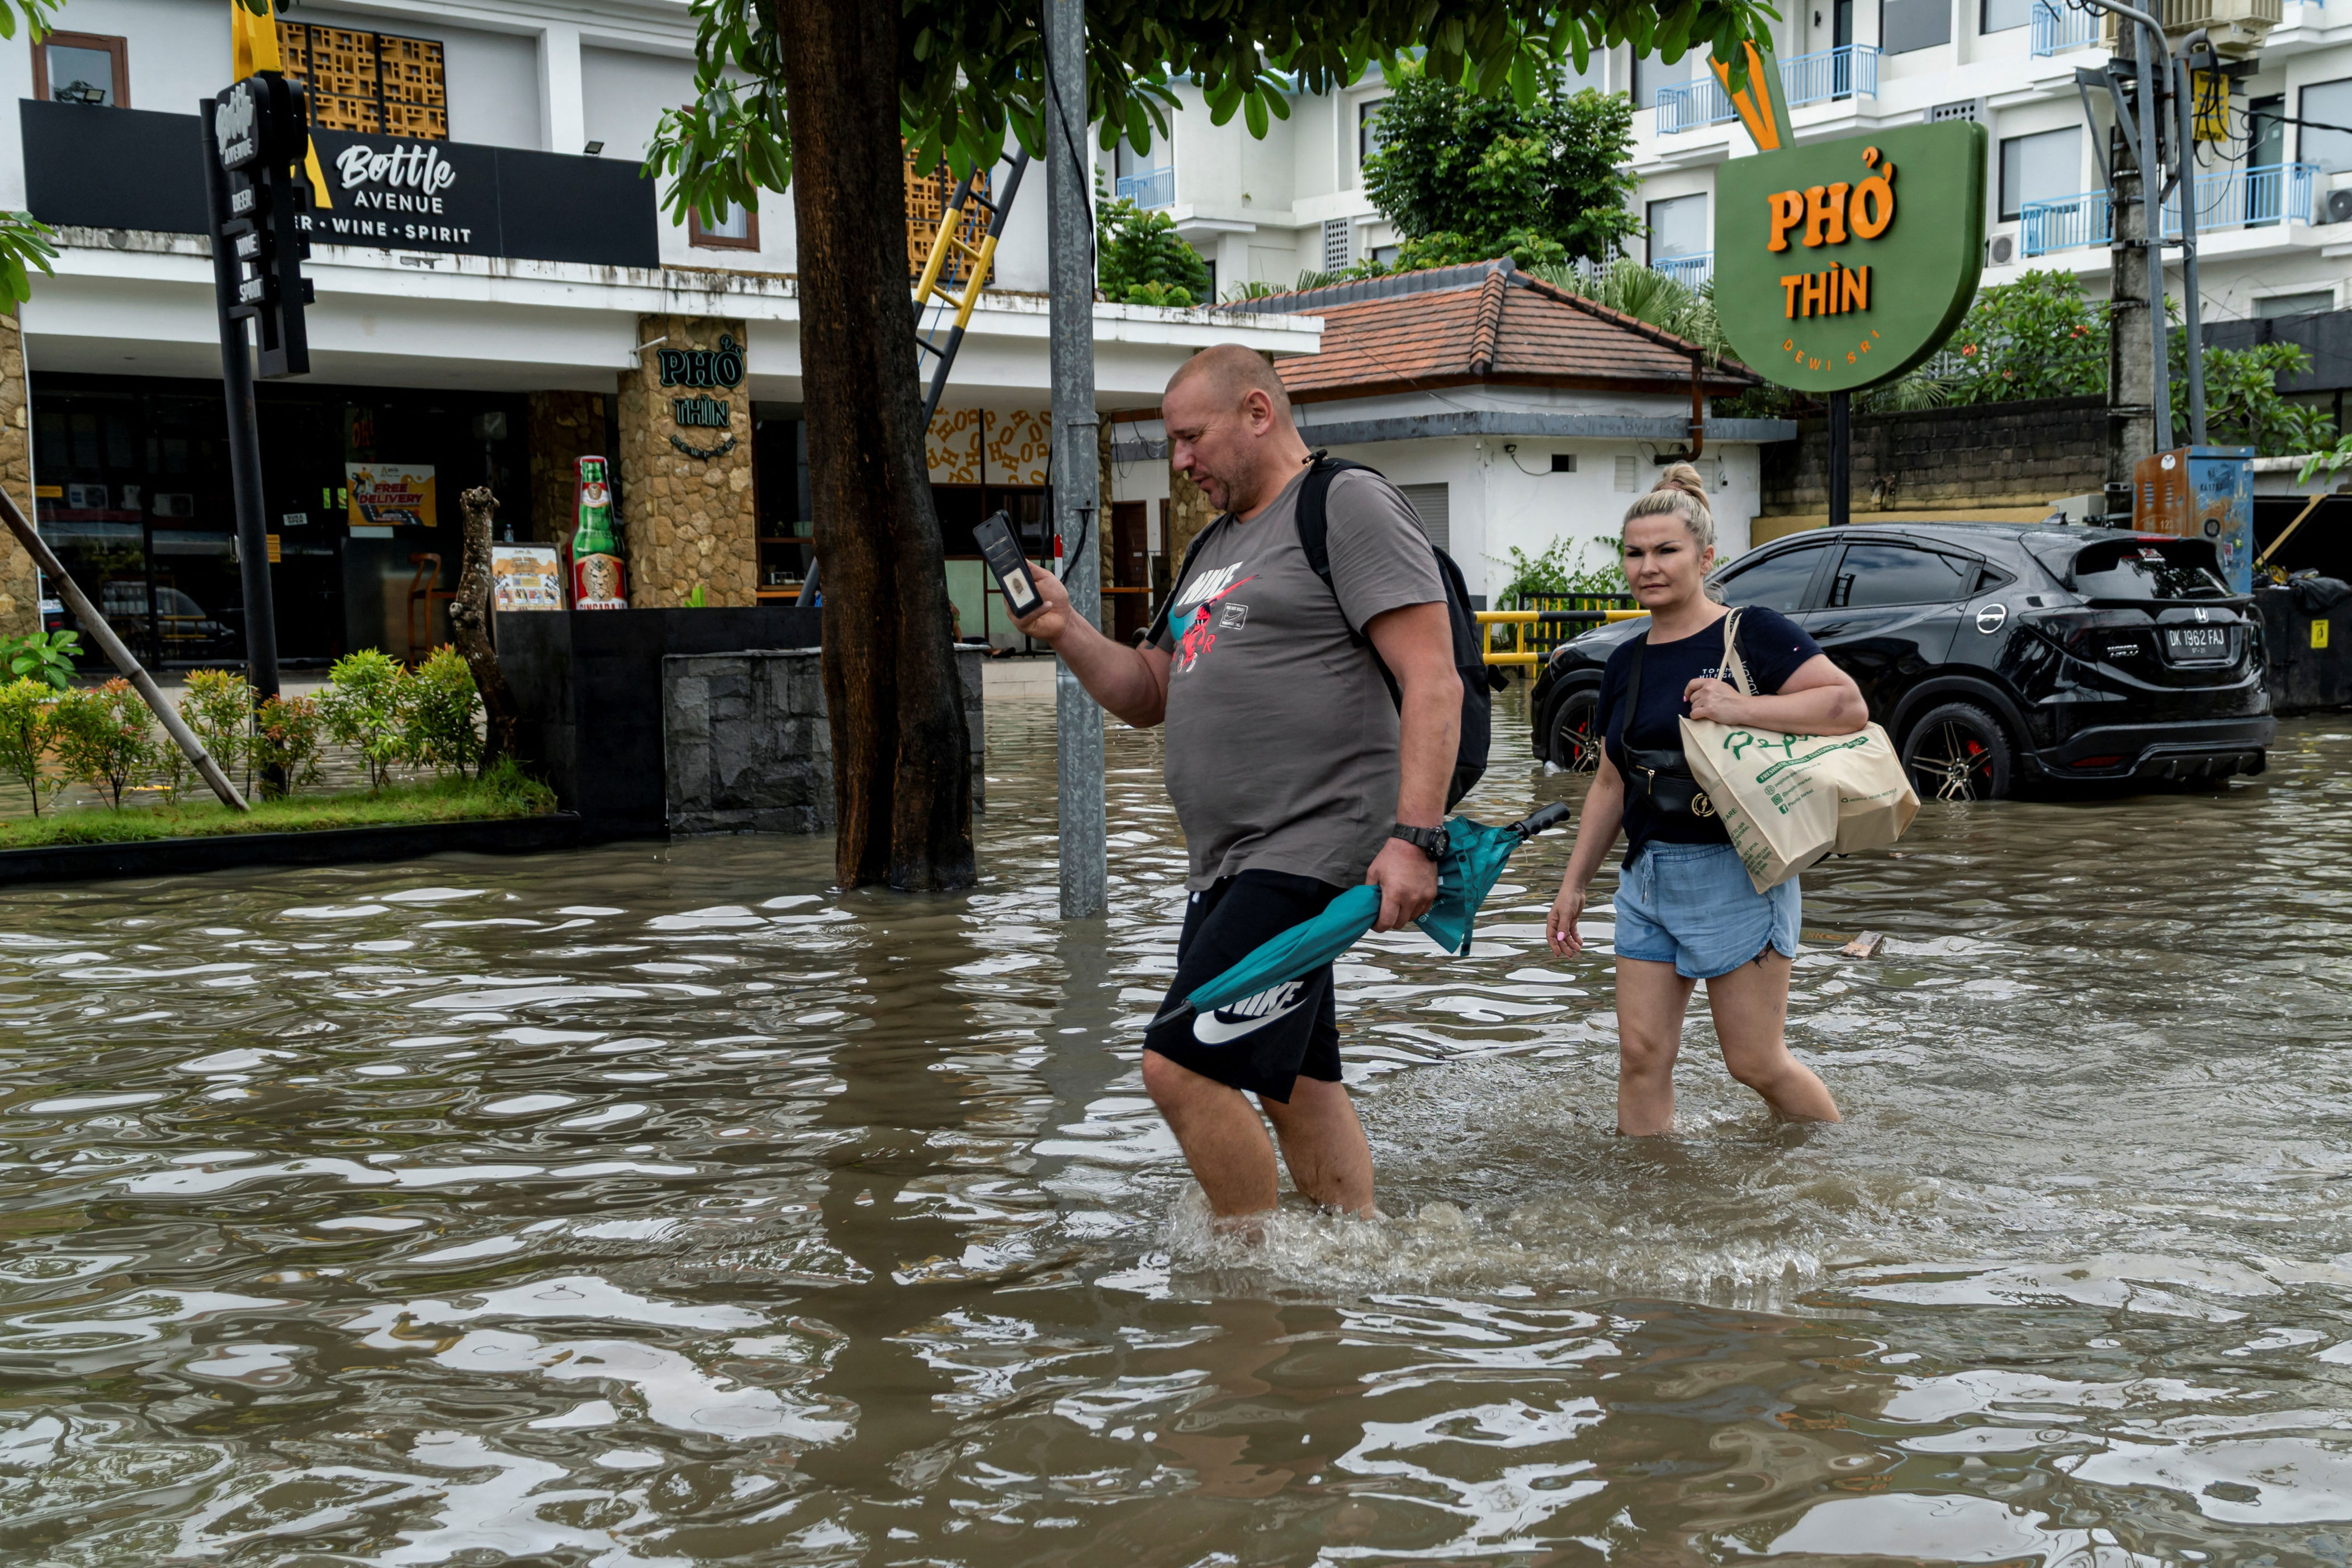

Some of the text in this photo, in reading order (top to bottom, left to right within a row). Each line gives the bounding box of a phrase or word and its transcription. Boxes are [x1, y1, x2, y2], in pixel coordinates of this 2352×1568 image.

[215, 82, 253, 155] Bottle
[225, 138, 253, 164] AVENUE
[336, 144, 456, 195] Bottle
[232, 189, 253, 212] BEER
[354, 191, 443, 214] AVENUE
[332, 217, 387, 236] WINE
[405, 224, 471, 243] SPIRIT
[236, 233, 258, 257] WINE
[239, 279, 262, 302] SPIRIT
[1780, 261, 1868, 319] THÌN
[1782, 329, 1880, 371] DEWI SRI
[673, 395, 729, 427] THÌN
[671, 435, 708, 458] DEWI
[358, 493, 424, 504] DELIVERY
[373, 483, 409, 493] FREE
[1176, 561, 1243, 607] NIKE
[2169, 629, 2225, 646] DK 1962 FAJ
